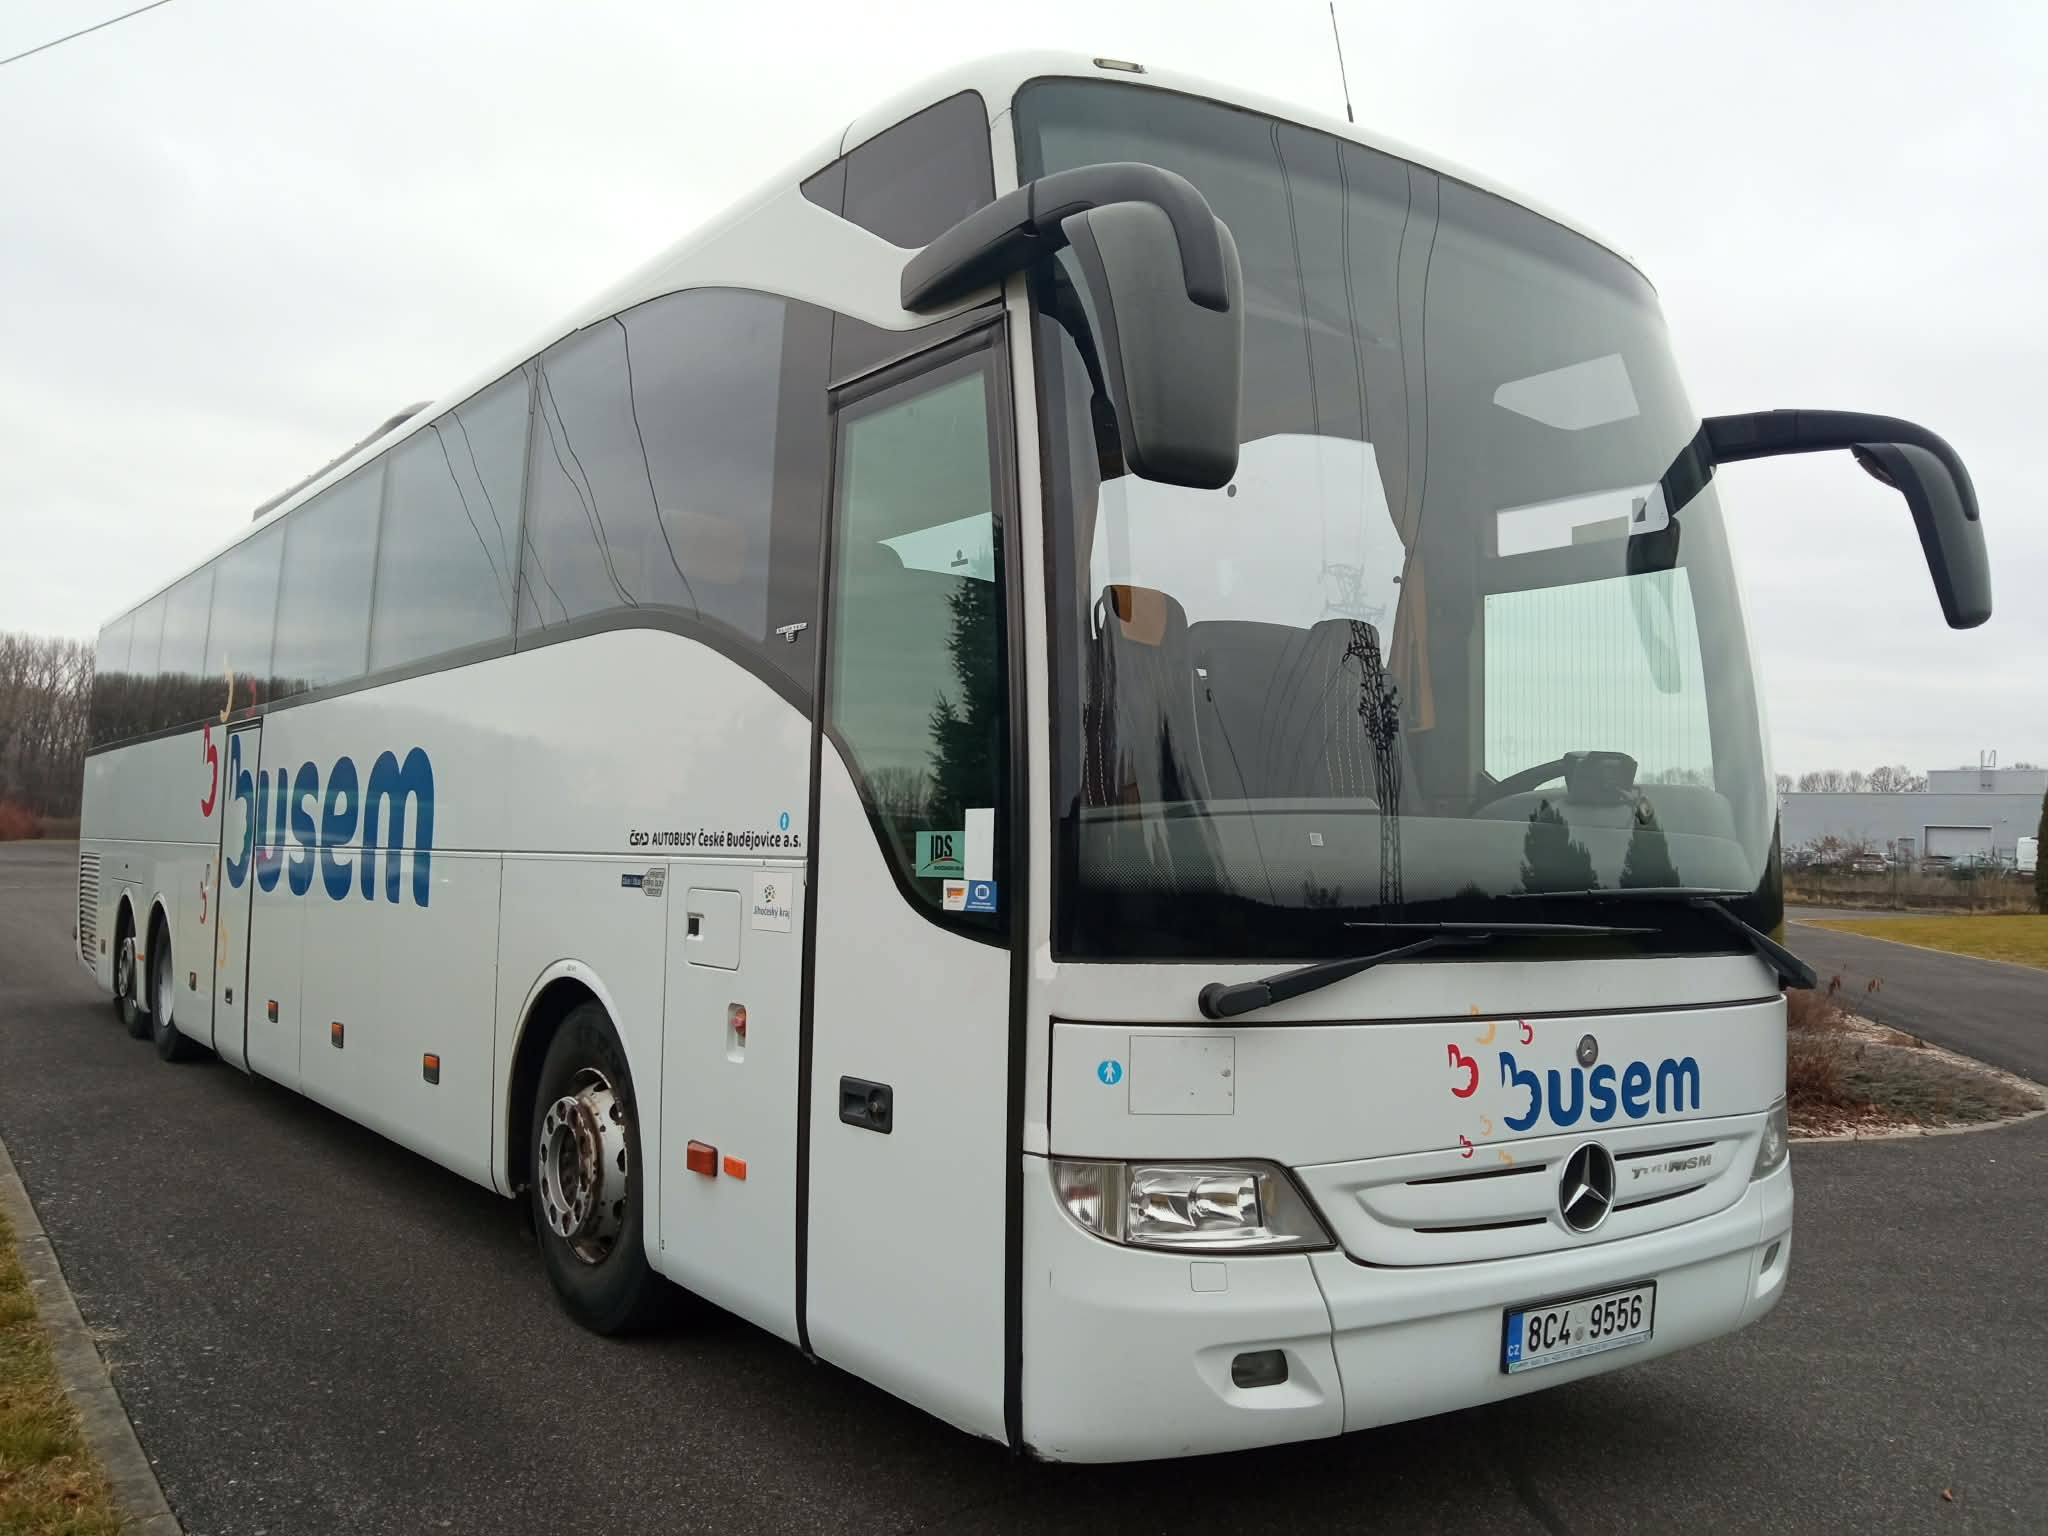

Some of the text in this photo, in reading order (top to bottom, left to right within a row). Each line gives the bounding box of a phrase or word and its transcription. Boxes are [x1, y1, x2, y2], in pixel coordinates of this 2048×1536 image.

[652, 831, 697, 846] AUTOBUSY
[698, 828, 725, 847] České
[726, 830, 781, 851] Budějovice
[783, 834, 802, 848] a.s.
[930, 834, 953, 862] IDS
[1528, 1310, 1571, 1353] 8C4
[1589, 1294, 1643, 1339] 9556
[1507, 1344, 1521, 1357] CZ
